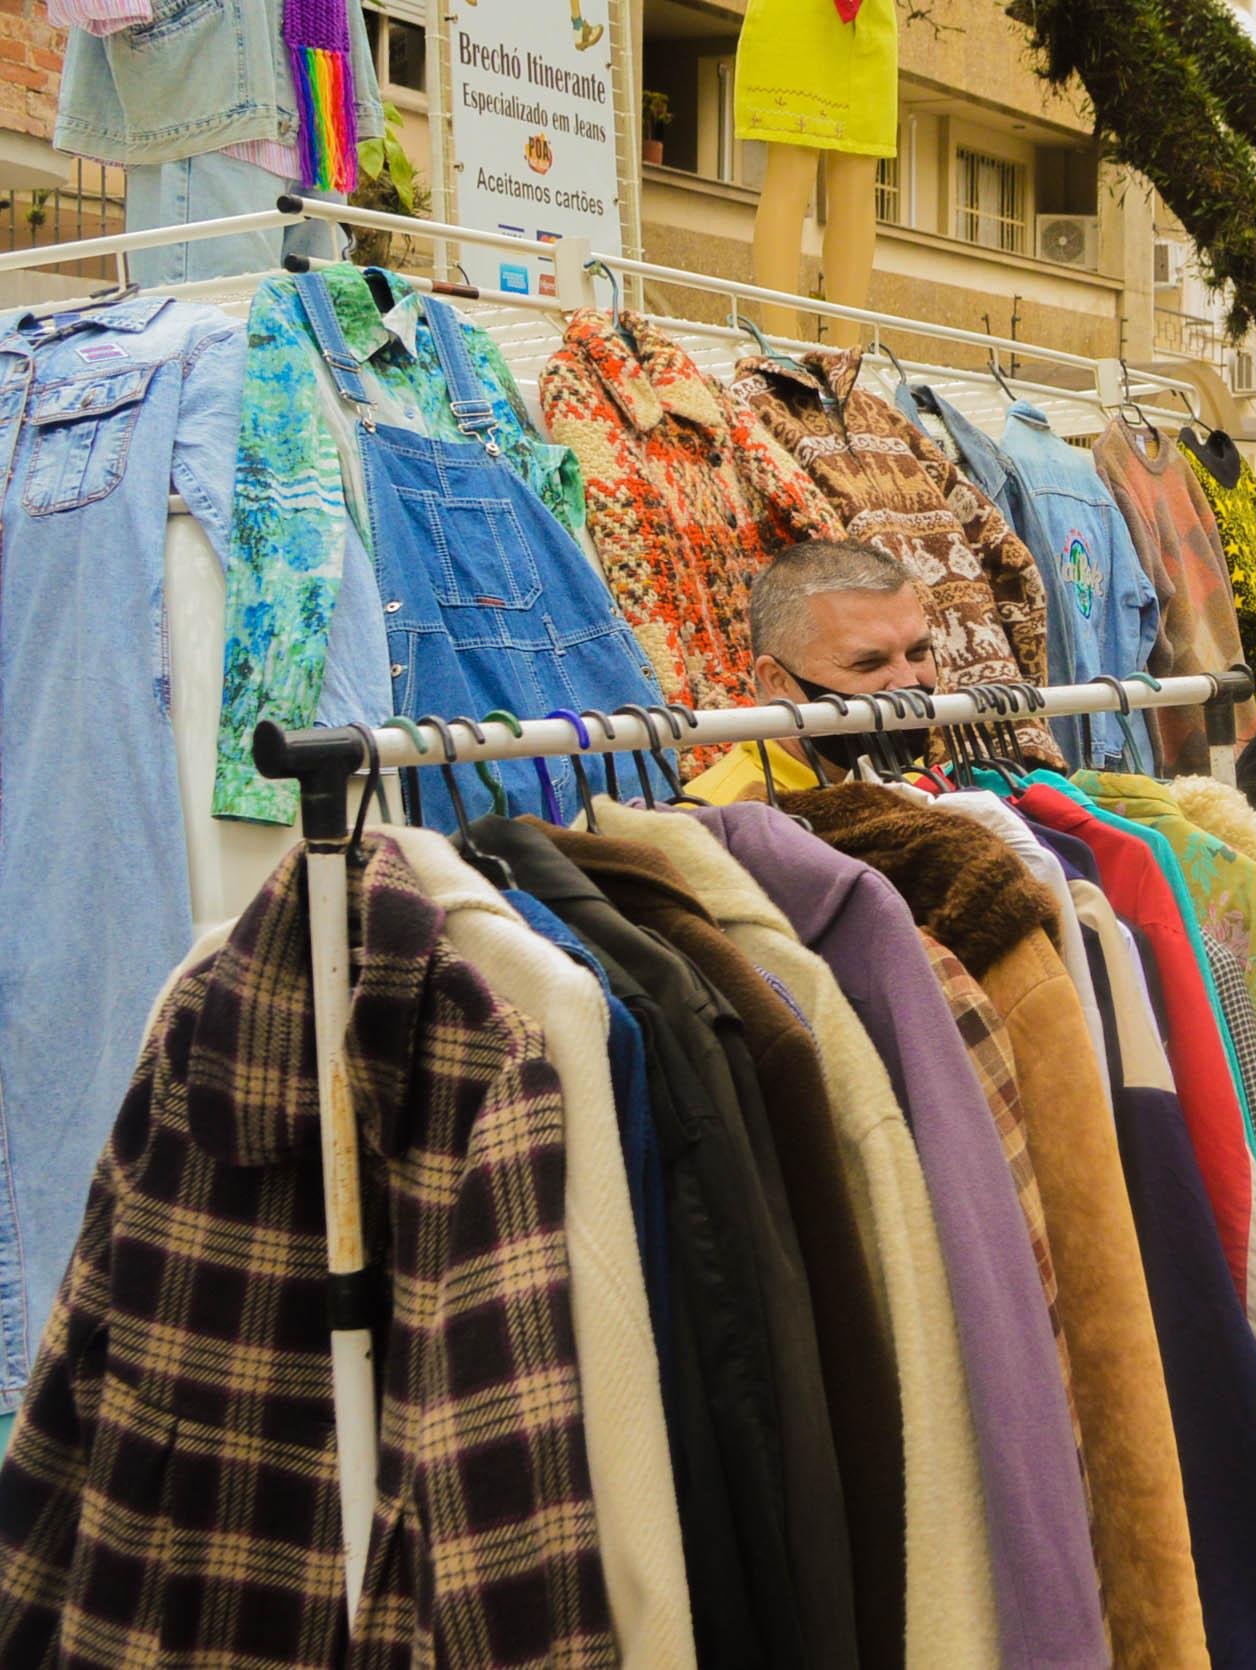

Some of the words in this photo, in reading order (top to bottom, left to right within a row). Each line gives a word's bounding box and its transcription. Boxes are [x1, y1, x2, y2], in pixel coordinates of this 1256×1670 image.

[459, 31, 521, 80] Brechó
[527, 52, 606, 104] Itinerante
[462, 82, 548, 127] Especializado
[552, 112, 570, 133] em
[575, 113, 606, 143] Jeans
[477, 167, 551, 204] Aceitamos
[555, 190, 604, 216] cartões
